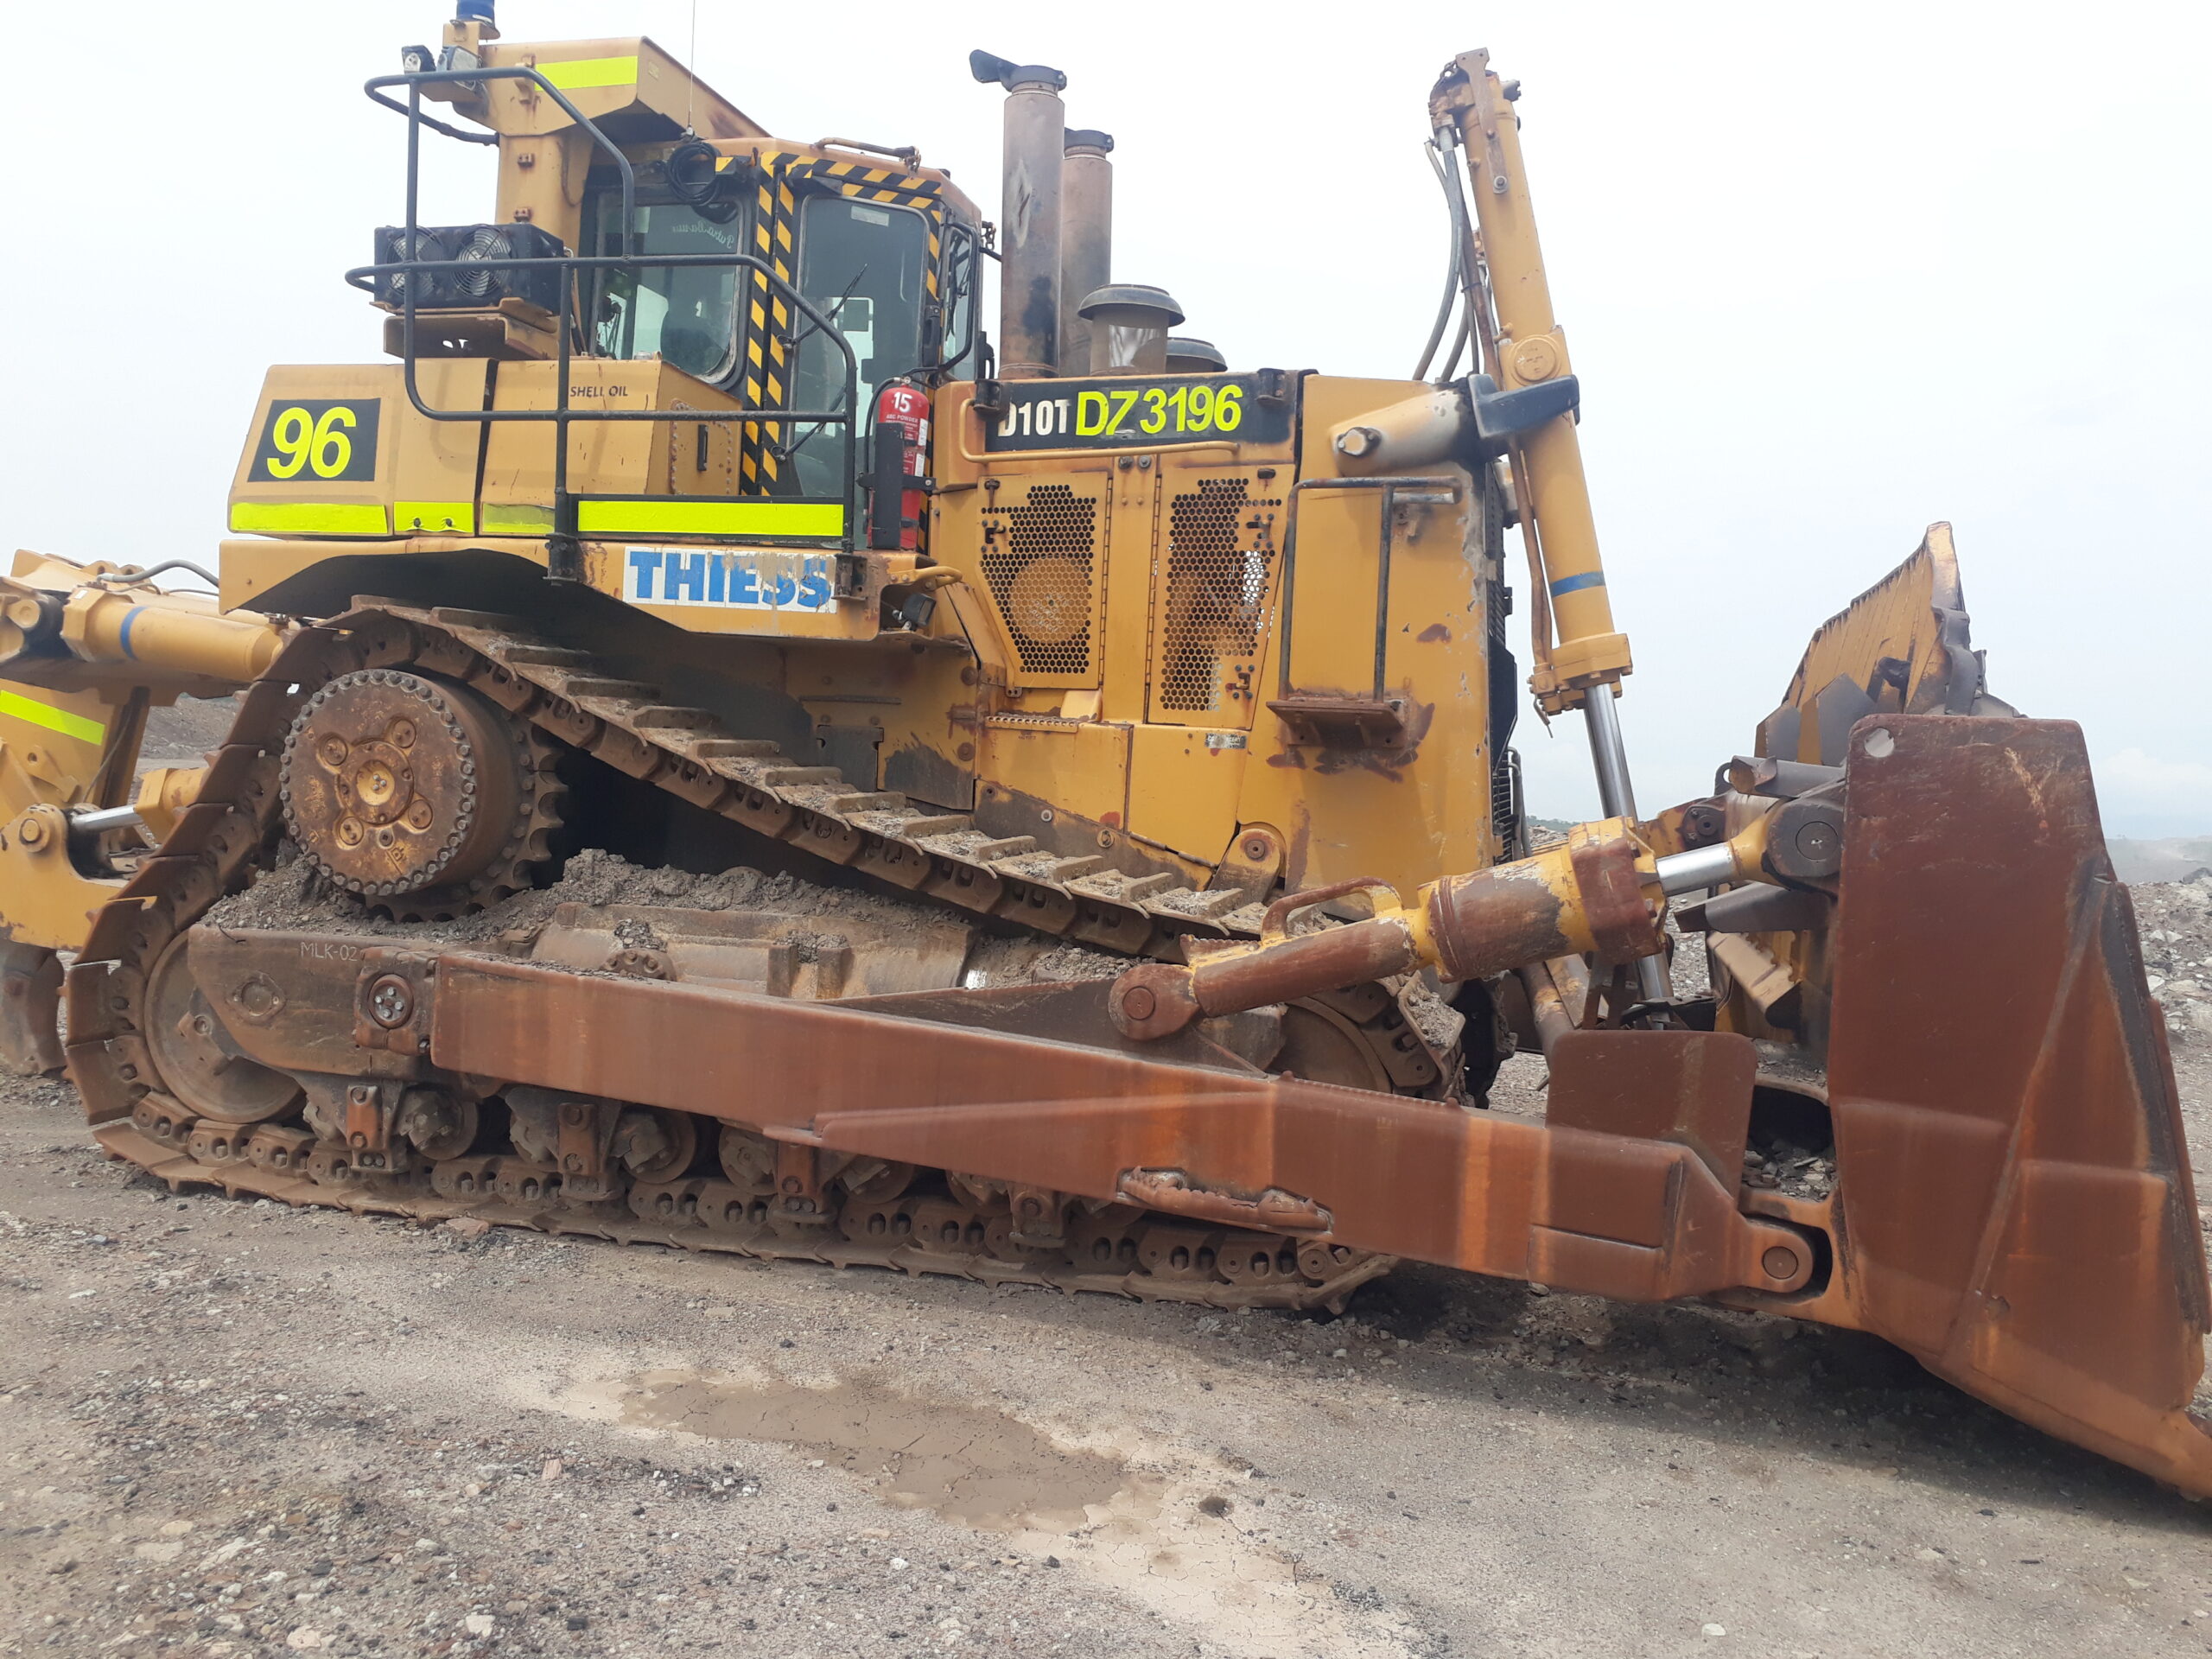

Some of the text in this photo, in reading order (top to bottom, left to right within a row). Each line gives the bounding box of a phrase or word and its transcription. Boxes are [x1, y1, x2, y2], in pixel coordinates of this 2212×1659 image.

[569, 385, 628, 397] SHELL OIL
[893, 391, 912, 413] 15
[998, 399, 1071, 436] D10T
[1140, 385, 1243, 432] 3196
[267, 406, 357, 479] 96
[629, 551, 831, 607] THIESS
[300, 941, 358, 962] MLK-02
